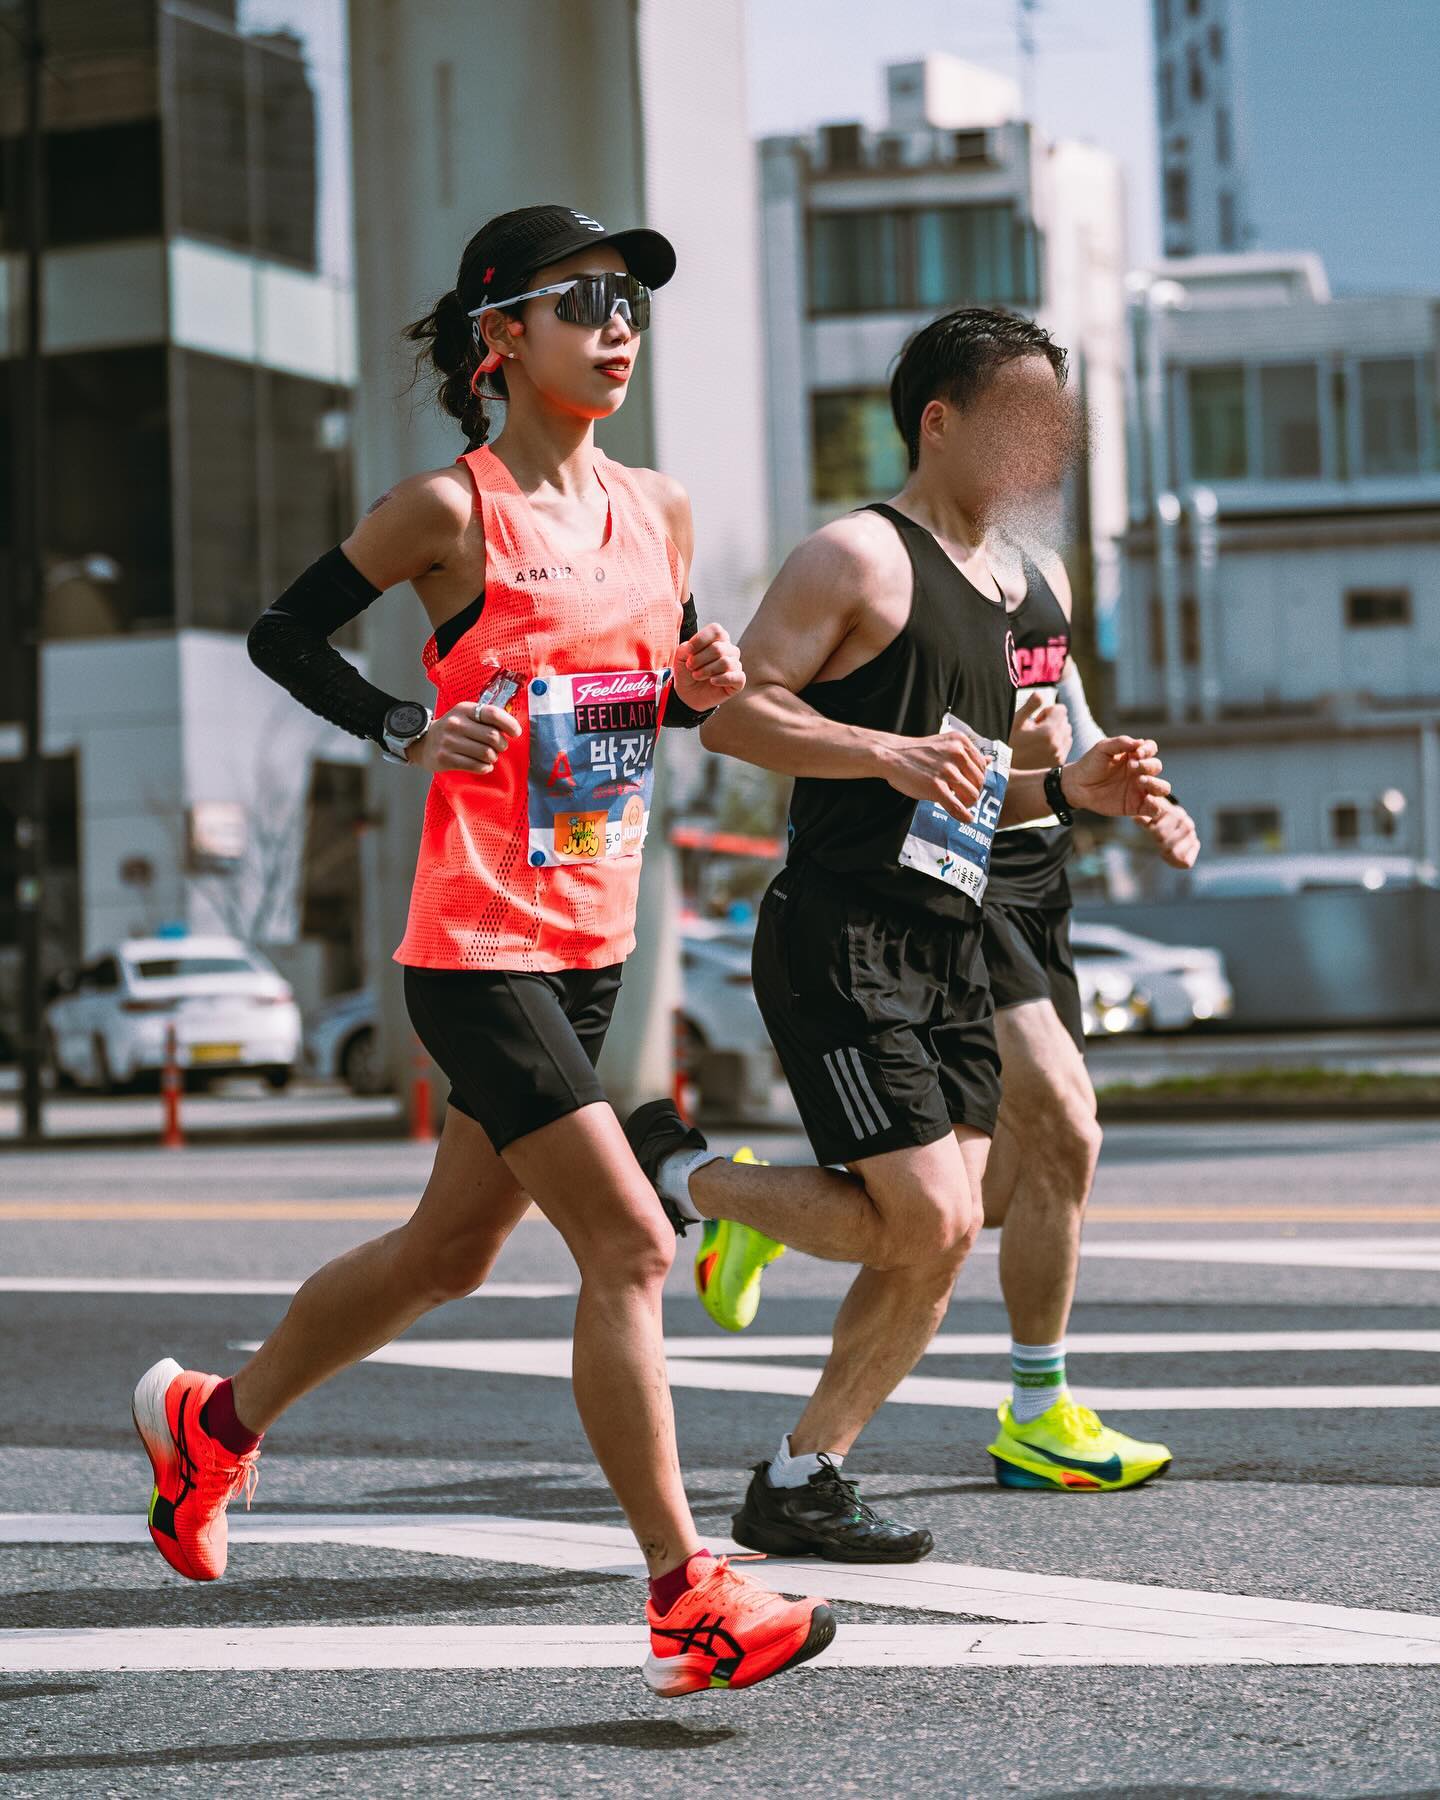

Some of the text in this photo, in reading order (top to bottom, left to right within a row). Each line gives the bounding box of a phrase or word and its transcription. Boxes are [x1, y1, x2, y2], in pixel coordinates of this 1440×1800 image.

[575, 675, 655, 704] Feellady
[576, 703, 656, 731] FEELLADY
[546, 751, 577, 787] A
